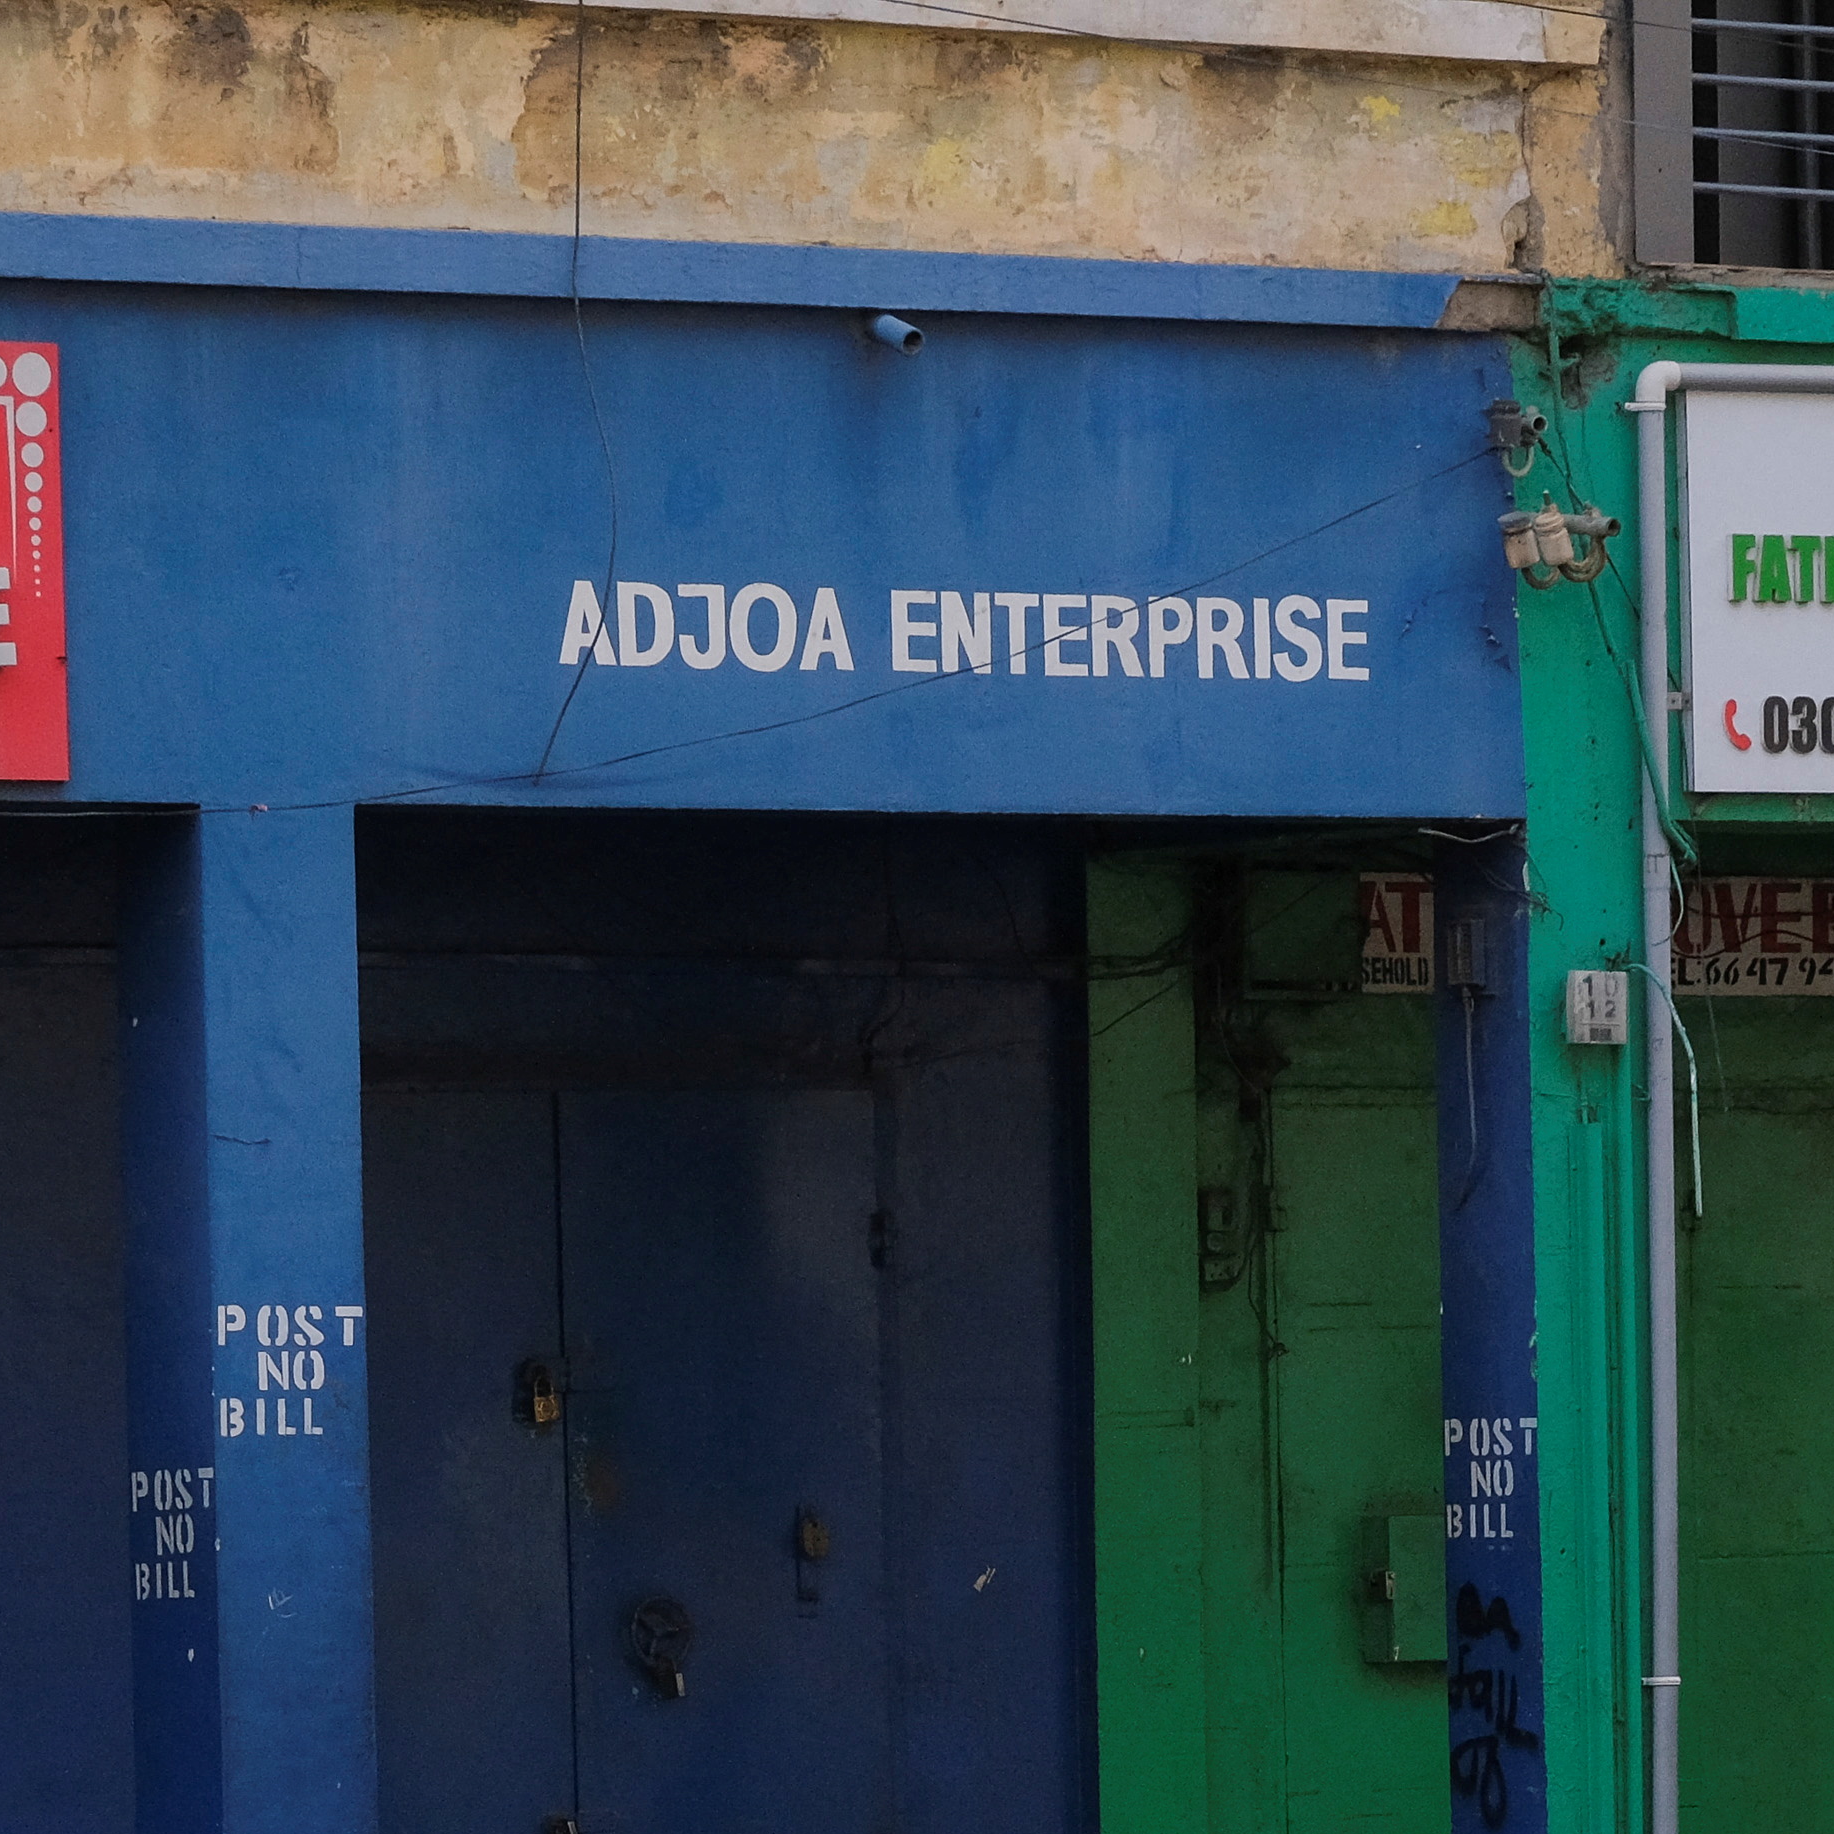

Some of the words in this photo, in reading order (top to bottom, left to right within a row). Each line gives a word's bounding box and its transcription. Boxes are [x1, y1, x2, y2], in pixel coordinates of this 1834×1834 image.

[558, 579, 856, 673] ADJOA
[889, 588, 1371, 684] ENTERPRISE
[216, 1304, 364, 1347] POST
[257, 1350, 326, 1391] NO
[219, 1397, 324, 1437] BILL
[1444, 1417, 1538, 1456] POST
[130, 1466, 214, 1512] POST
[1470, 1459, 1514, 1498] NO
[154, 1513, 195, 1556] NO
[1447, 1503, 1514, 1539] BILL
[134, 1560, 196, 1601] BILL
